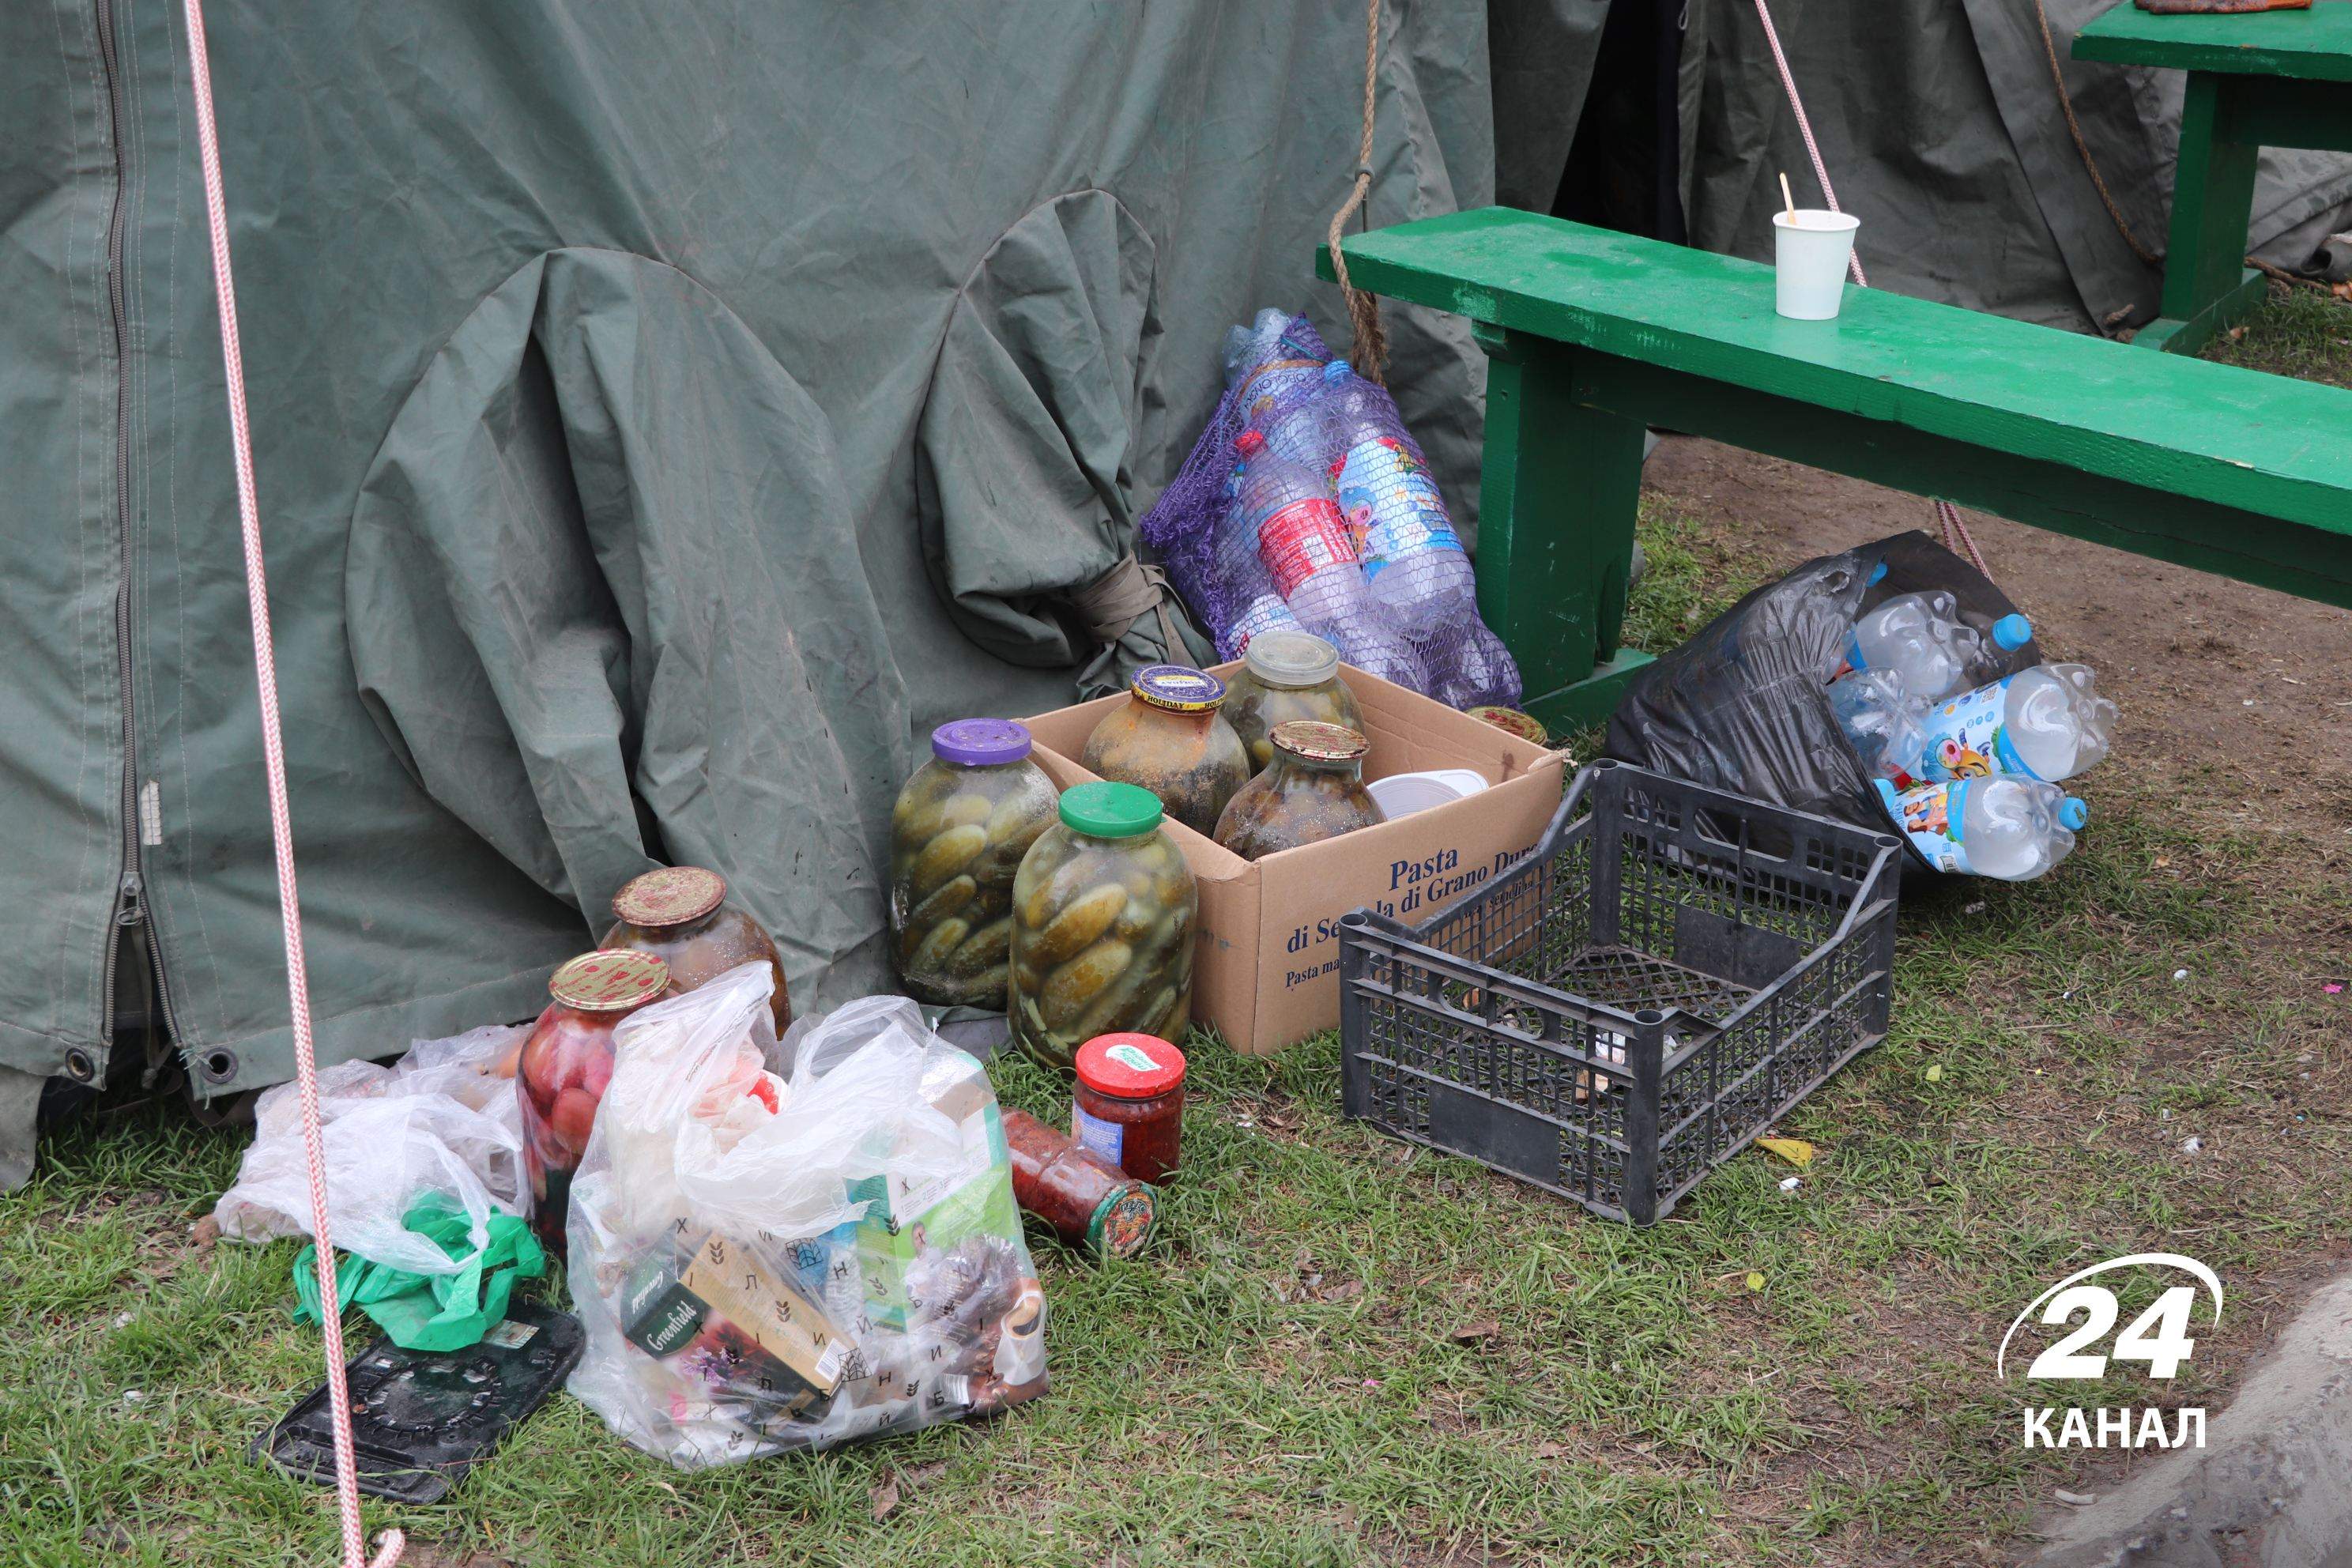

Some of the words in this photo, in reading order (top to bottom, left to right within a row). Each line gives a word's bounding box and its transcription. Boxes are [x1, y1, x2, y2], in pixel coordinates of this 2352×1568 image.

[1148, 695, 1185, 709] HOLIDAY
[1389, 848, 1458, 891] Pasta
[1287, 925, 1308, 953] di
[1400, 886, 1421, 913] di
[1427, 865, 1488, 902] Grano
[1286, 964, 1318, 988] Pasta
[646, 1300, 697, 1351] Greenfield
